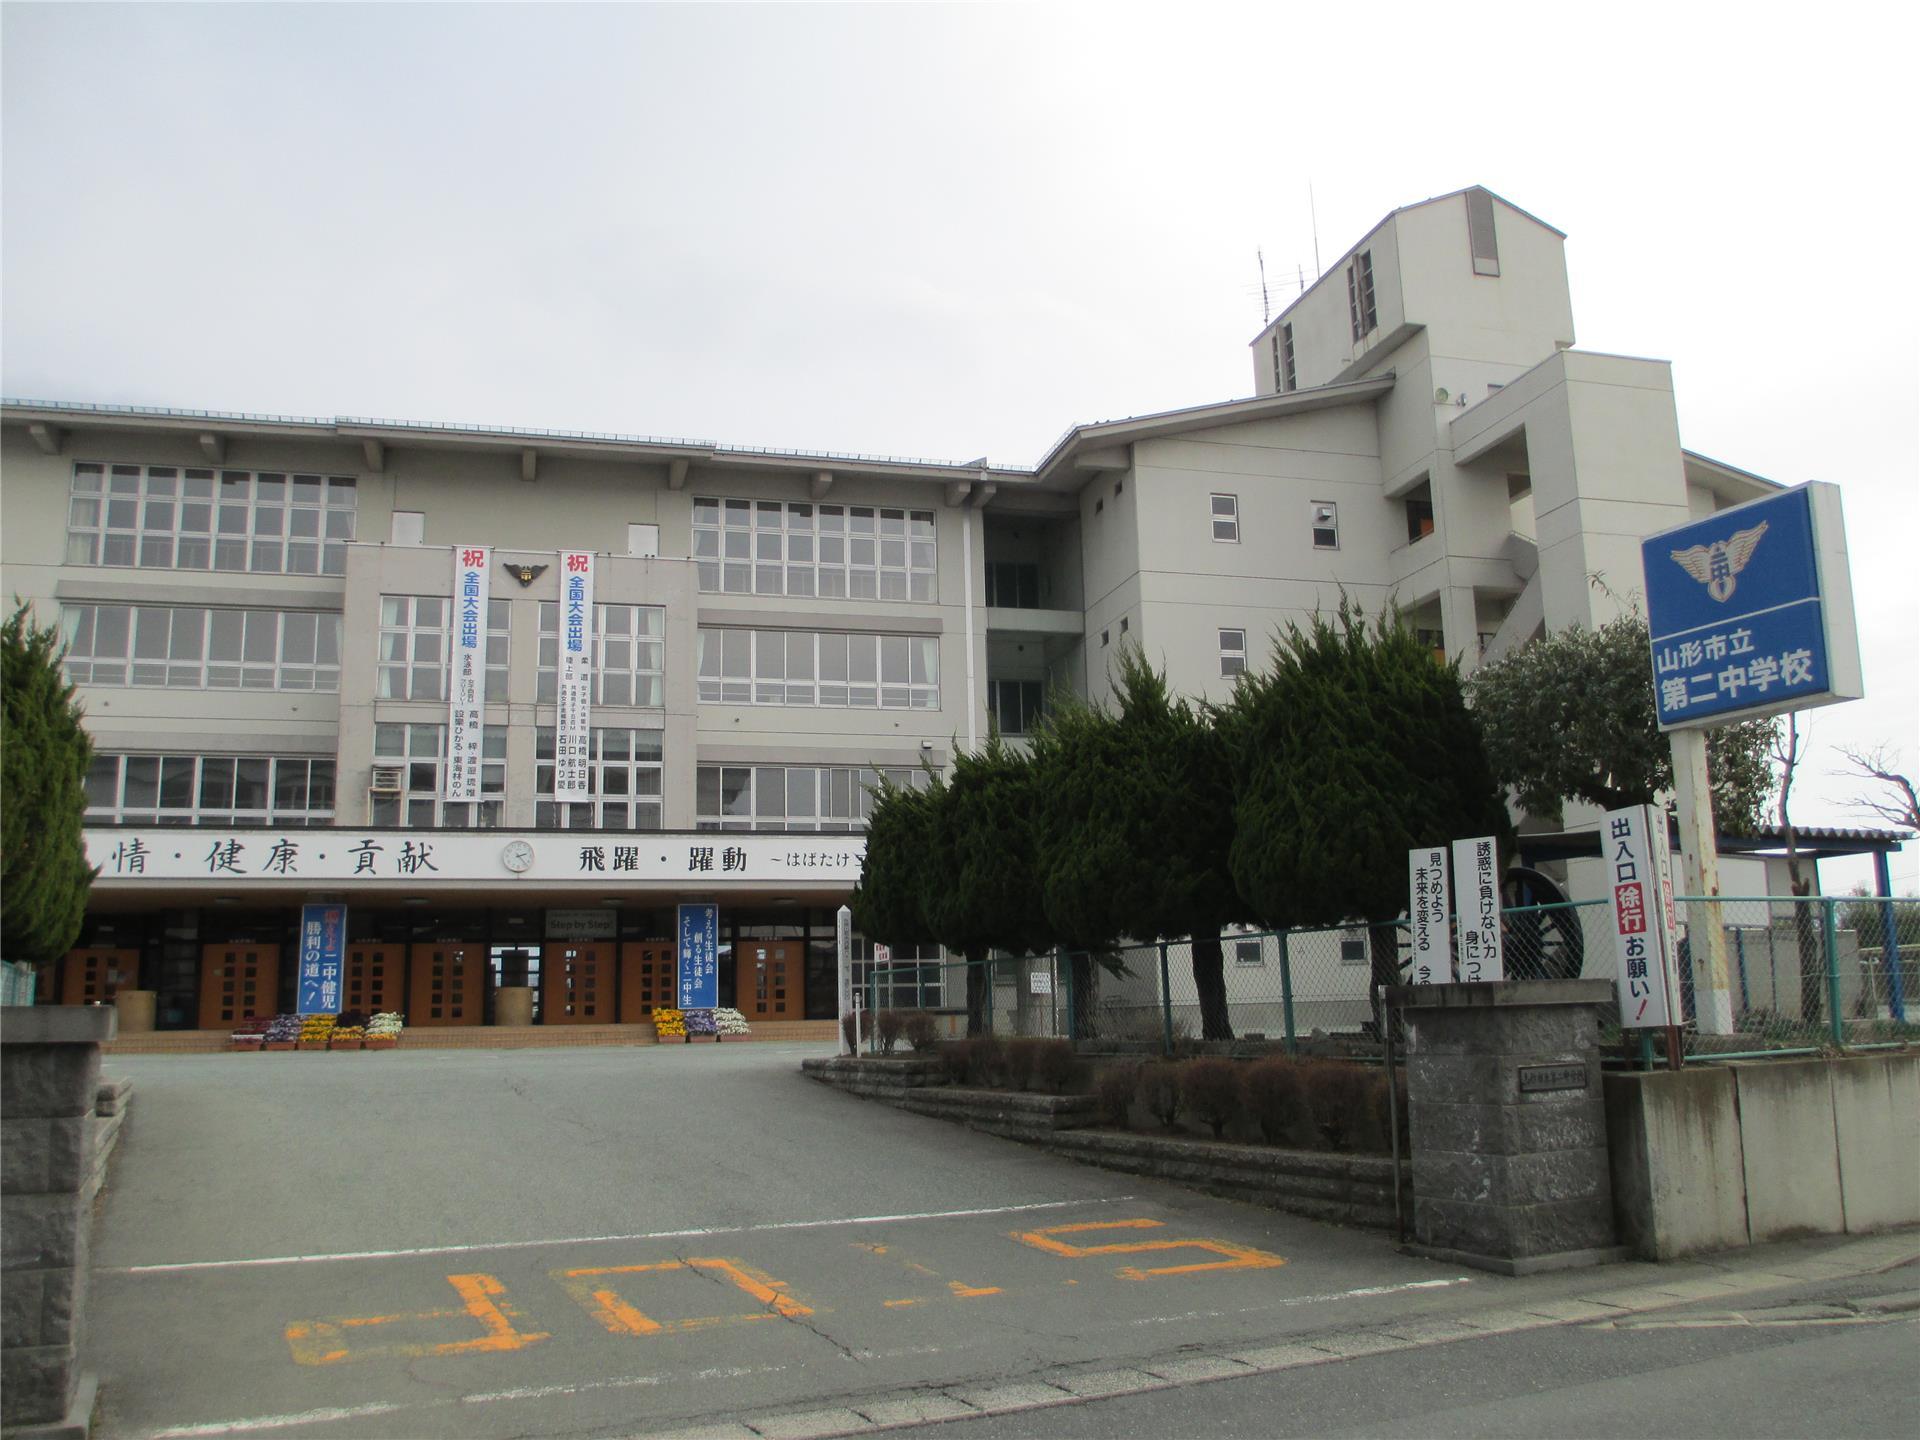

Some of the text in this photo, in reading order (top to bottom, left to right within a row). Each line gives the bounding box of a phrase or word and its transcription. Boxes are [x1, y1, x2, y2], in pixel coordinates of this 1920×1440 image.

[463, 549, 485, 569] 祝
[567, 554, 588, 573] 祝
[462, 571, 480, 649] 全国大会出場
[567, 575, 585, 652] 全国大会出場
[1657, 628, 1755, 674] 山形市立
[1661, 647, 1815, 713] 第二中学校
[1415, 868, 1430, 951] 未来を変える
[1430, 852, 1444, 924] 見つめよう
[1476, 842, 1497, 960] 誘惑に負けない力
